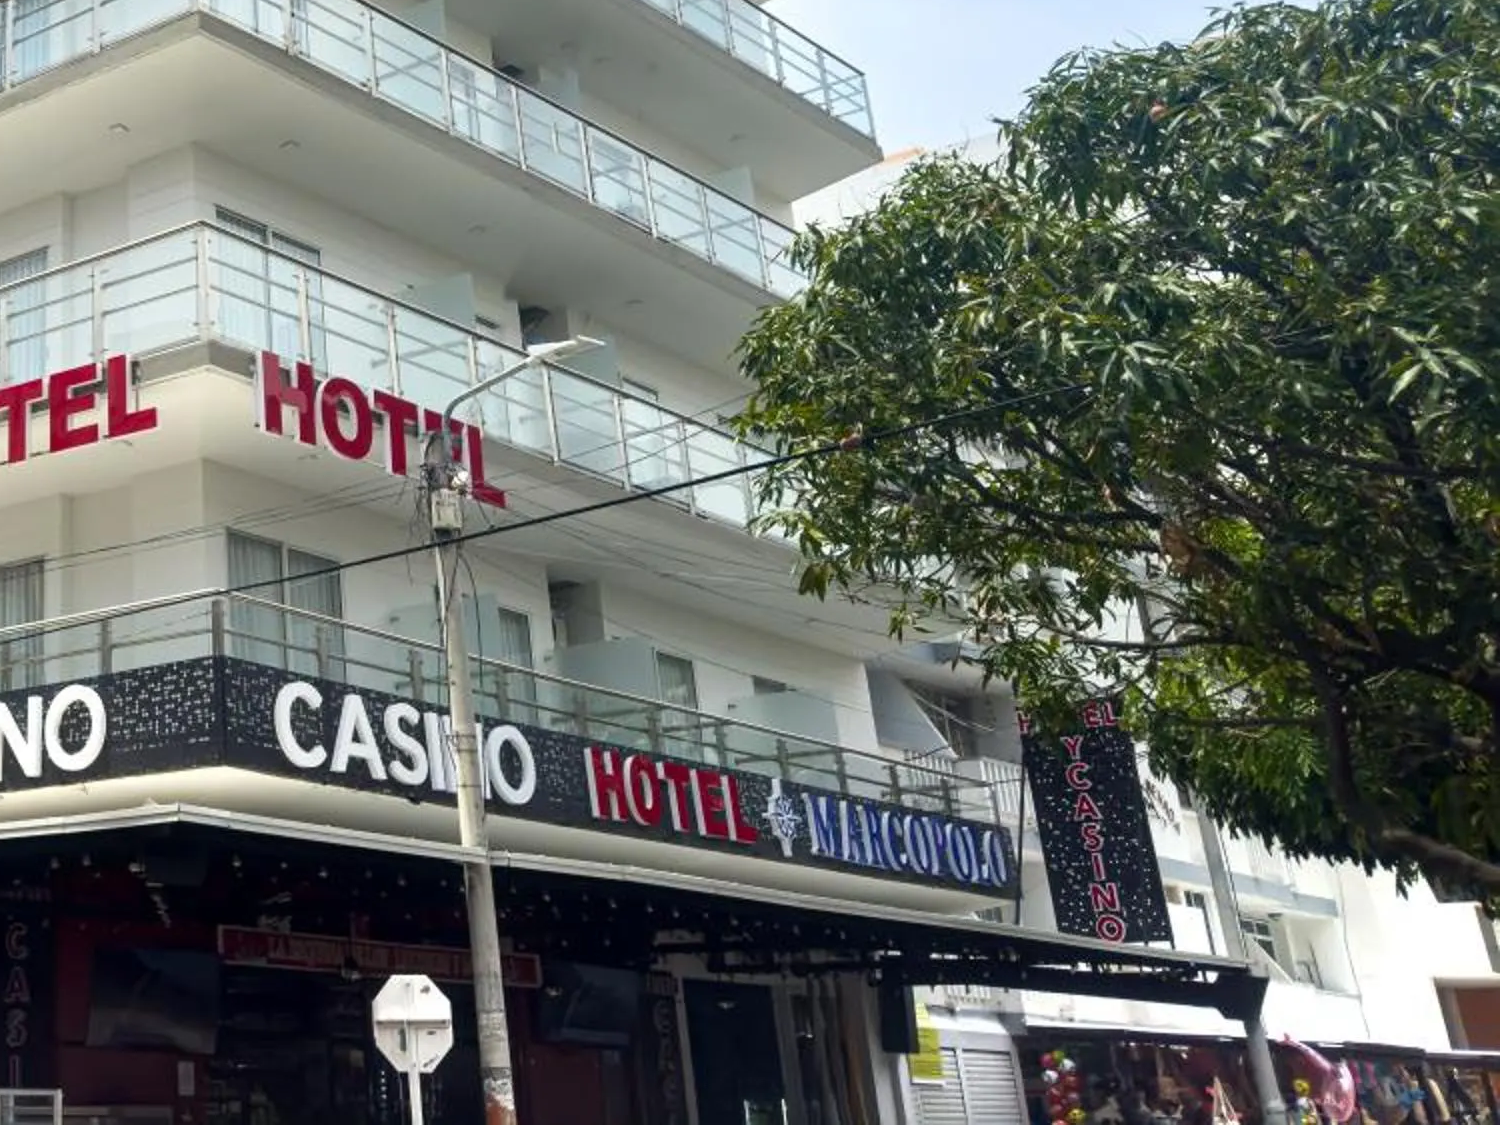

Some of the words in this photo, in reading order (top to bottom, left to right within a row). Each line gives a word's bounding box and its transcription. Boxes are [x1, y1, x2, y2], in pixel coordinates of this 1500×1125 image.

[585, 745, 758, 844] HOTEL
[802, 791, 1008, 887] MARCOPOLO
[1060, 736, 1084, 759] Y
[1065, 762, 1126, 944] CASINO
